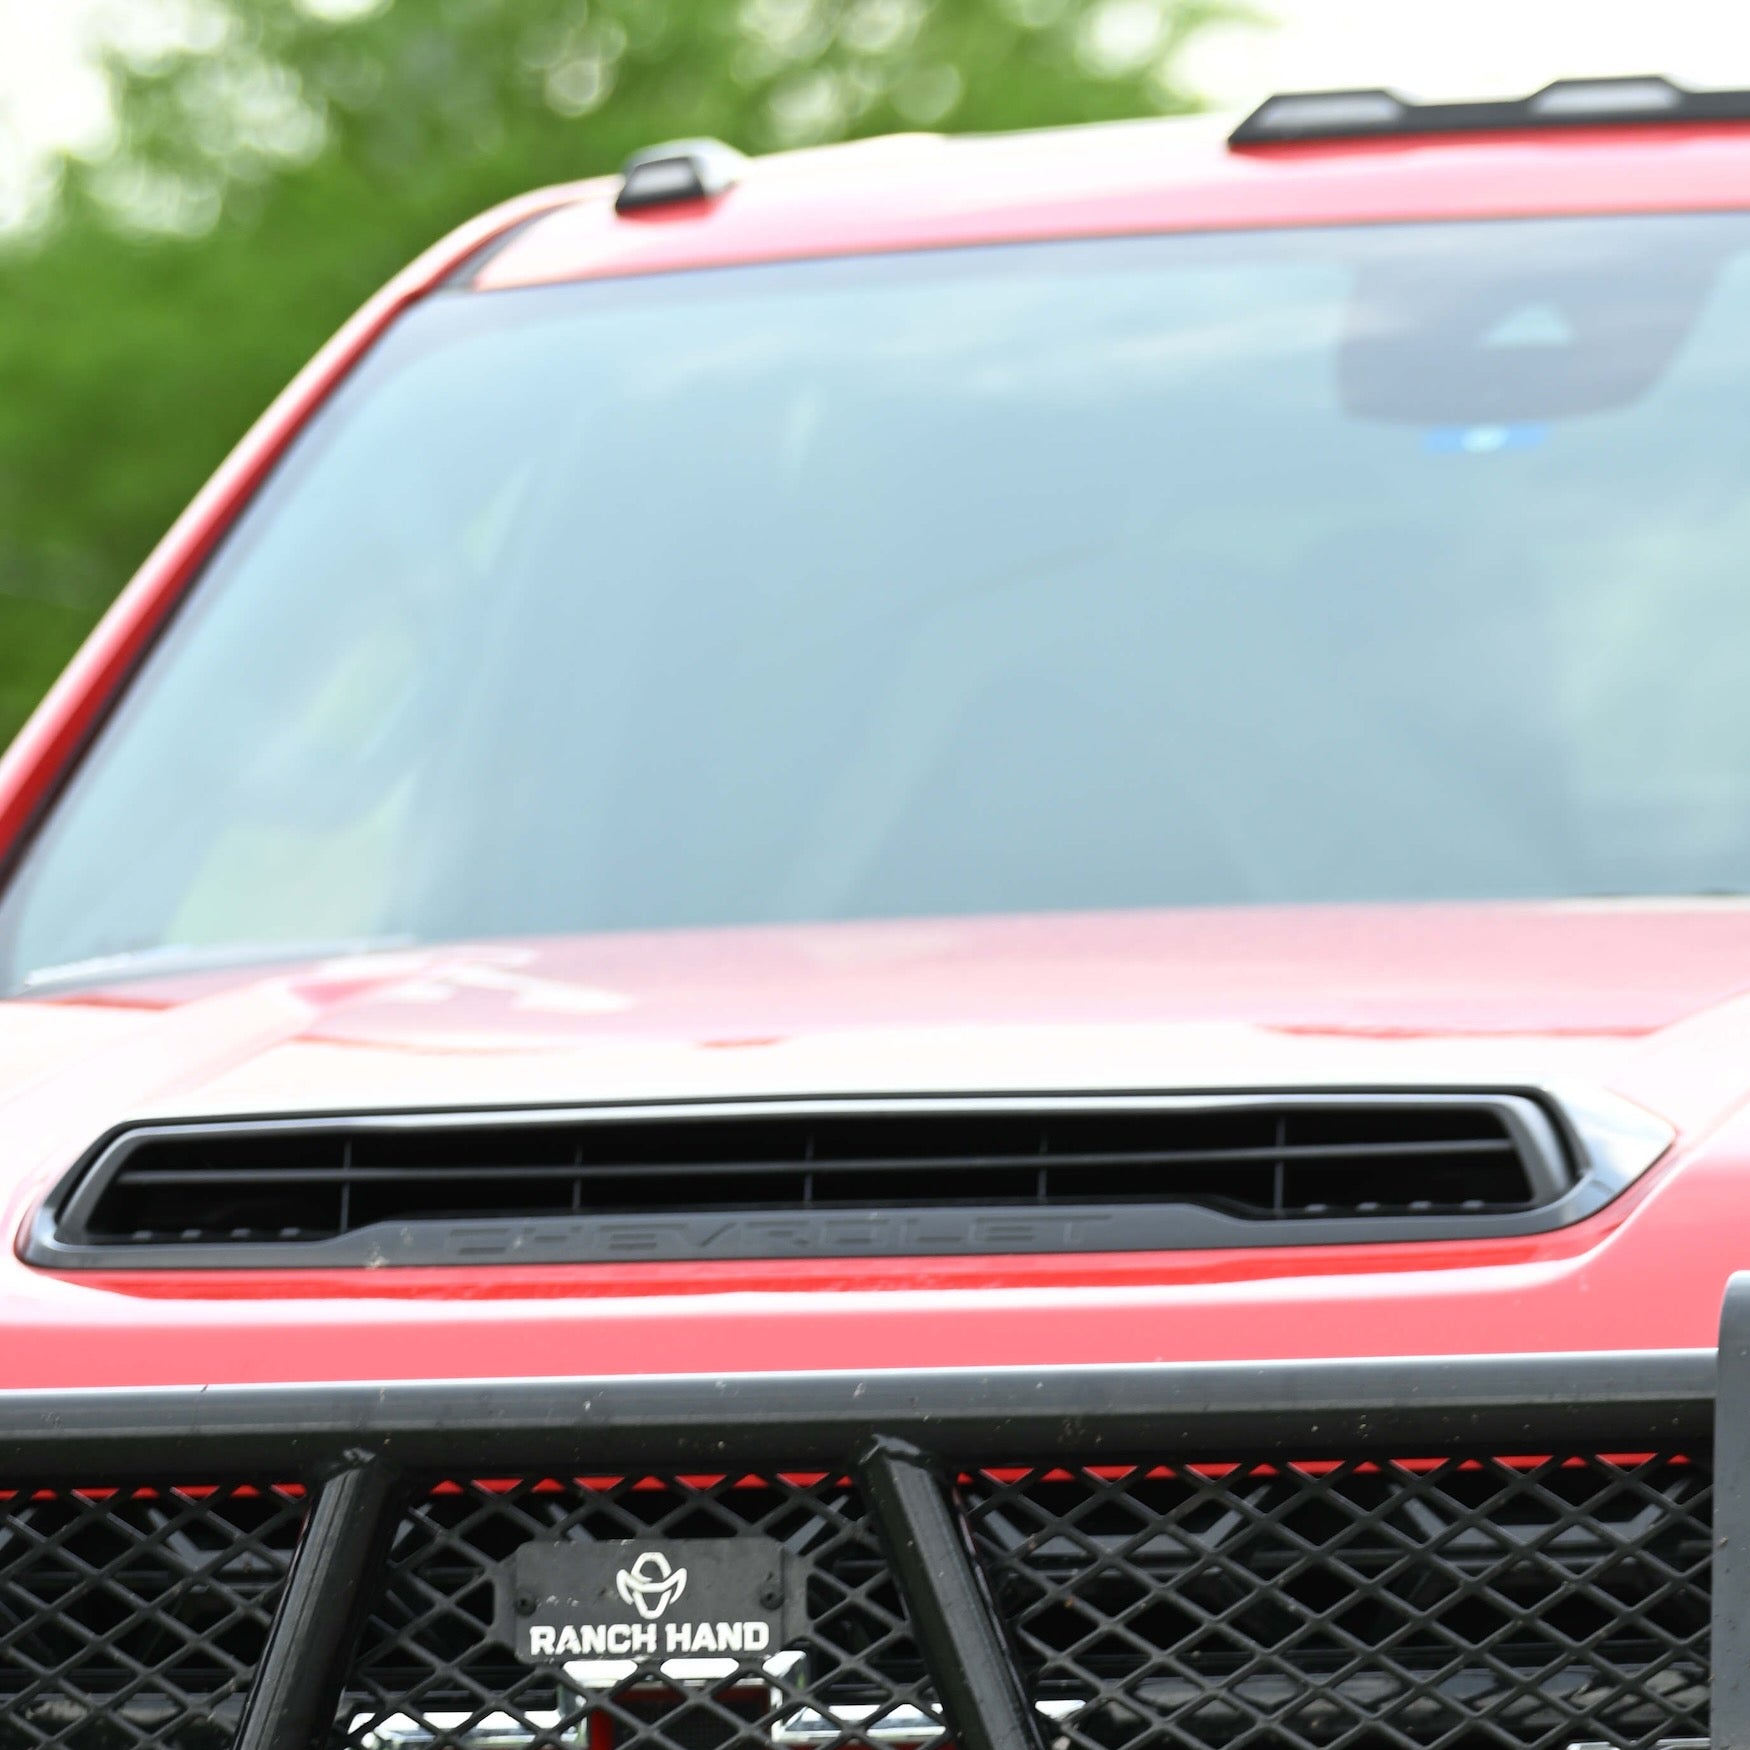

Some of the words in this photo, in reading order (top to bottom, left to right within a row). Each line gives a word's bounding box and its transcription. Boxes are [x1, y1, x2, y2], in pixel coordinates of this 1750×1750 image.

[445, 1214, 1113, 1259] CHEVROLET
[529, 1623, 657, 1655] RANCH
[665, 1621, 770, 1652] HAND
